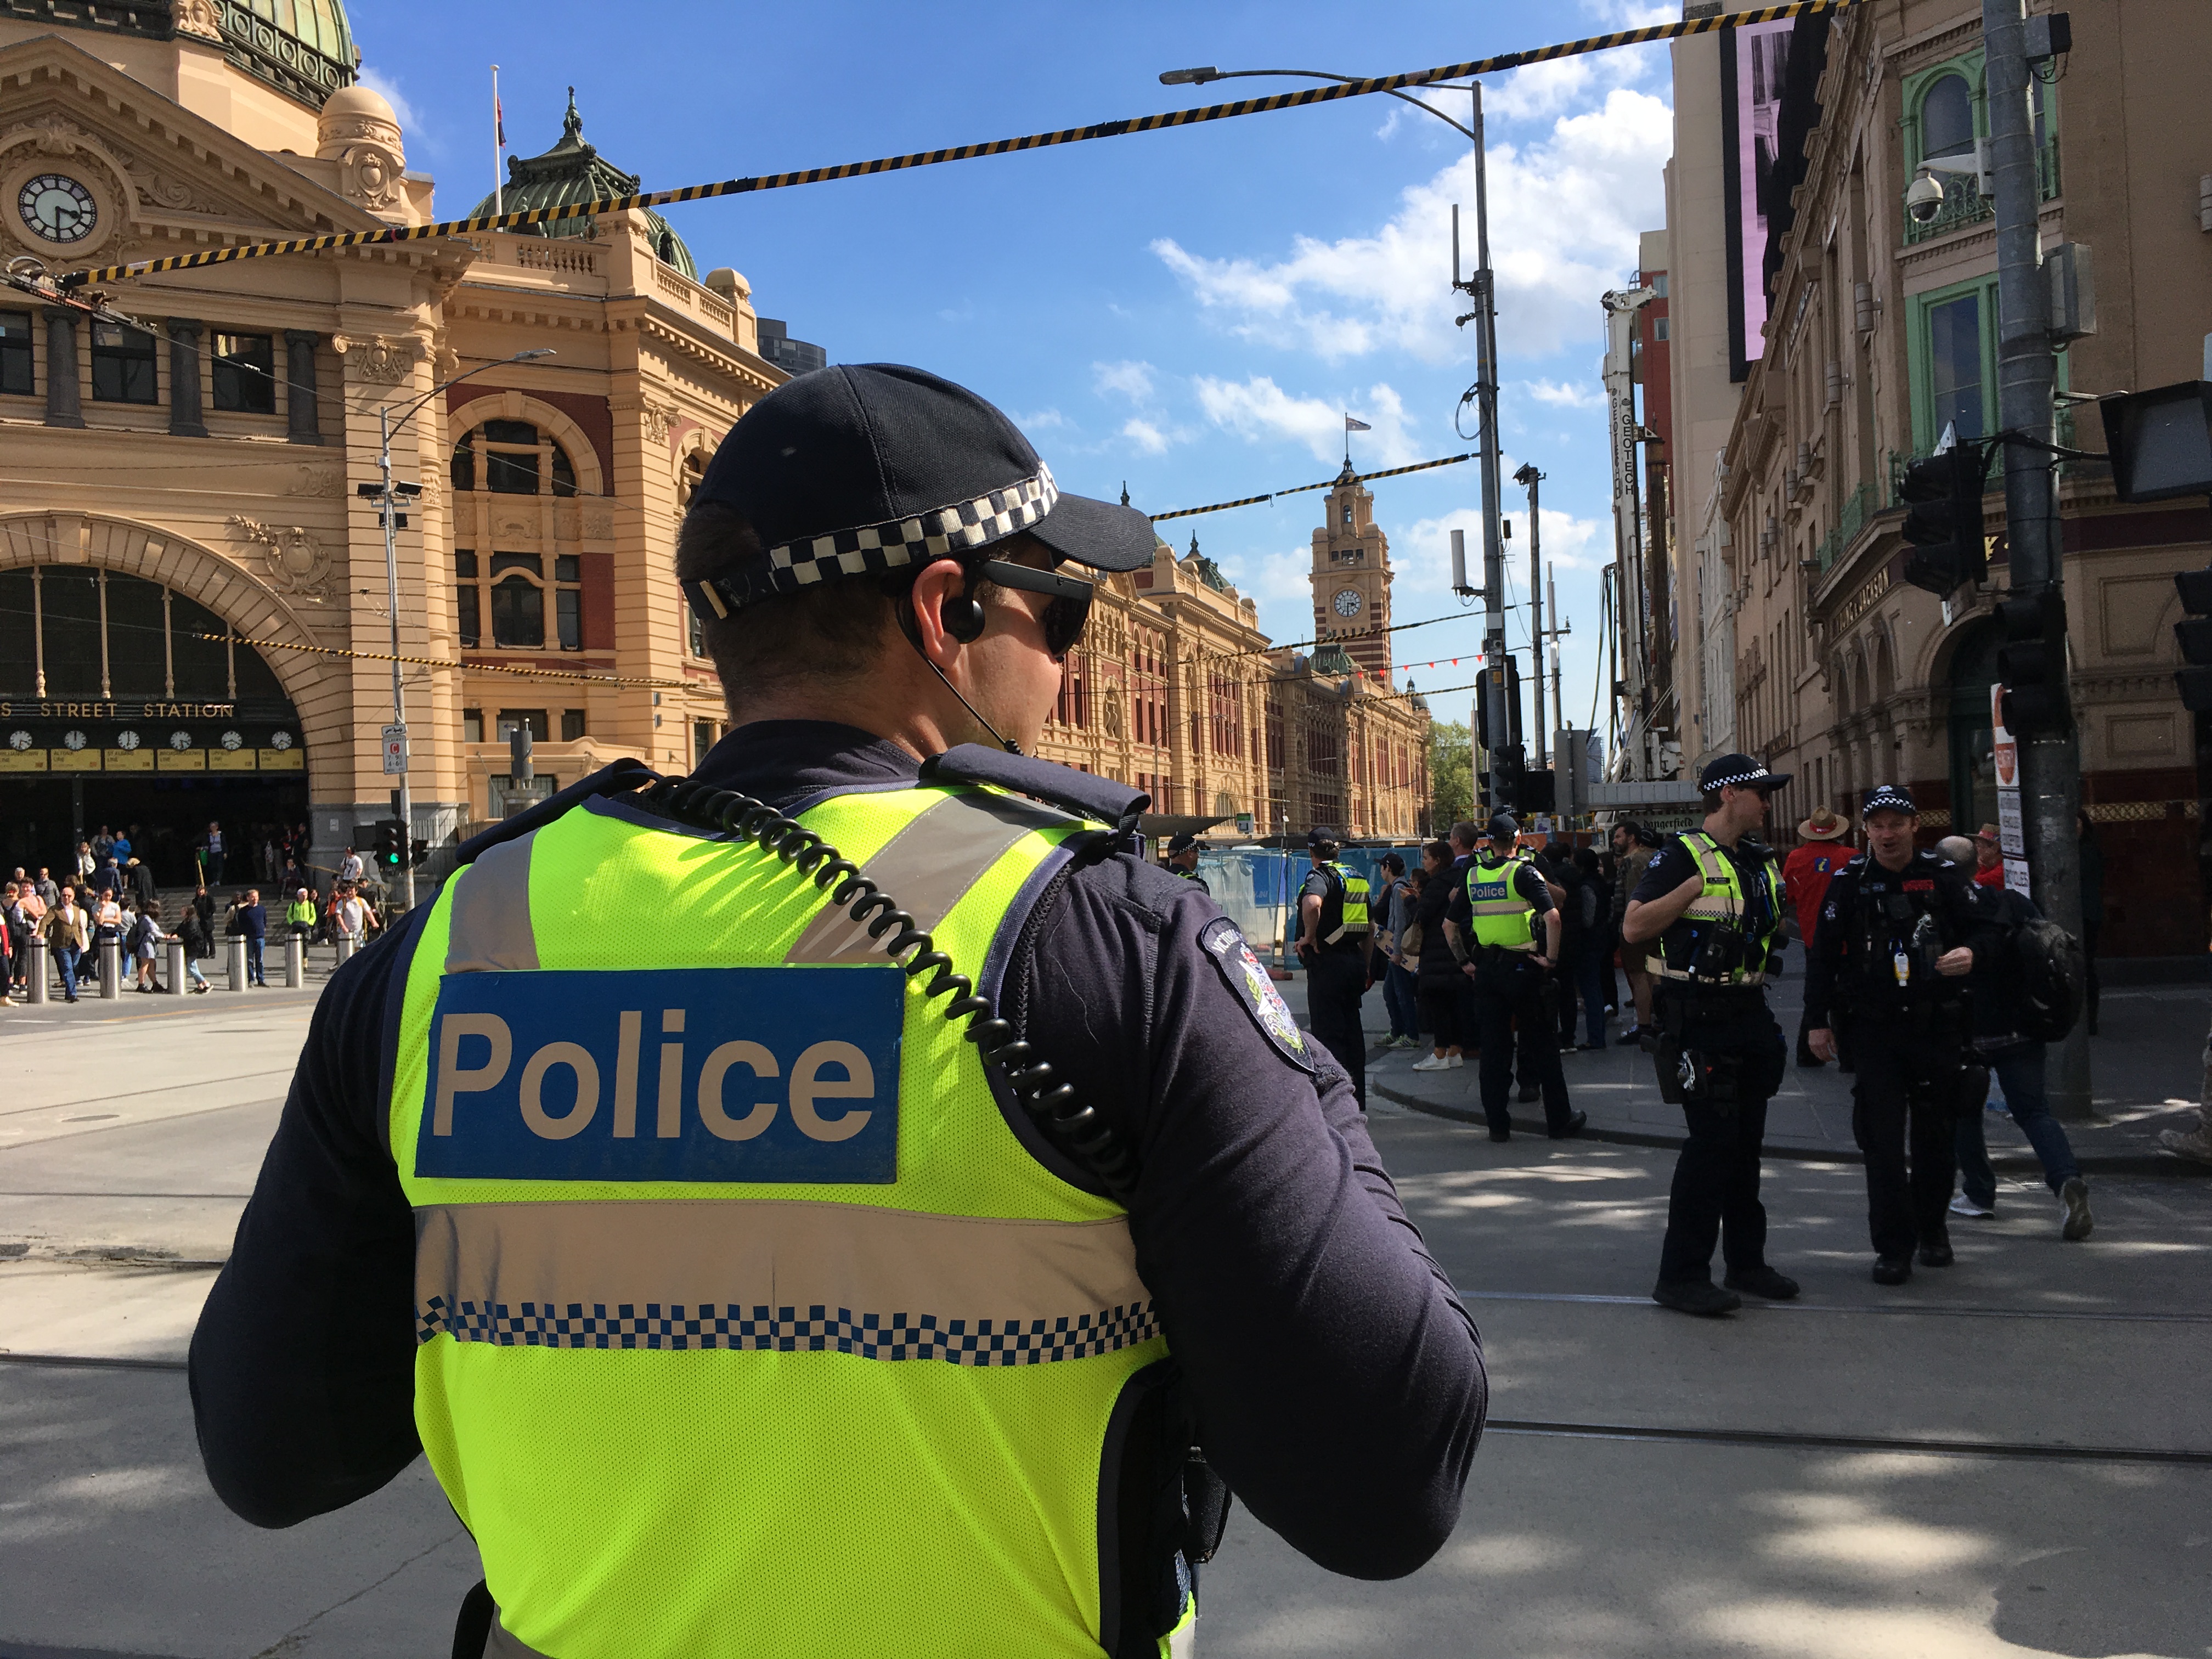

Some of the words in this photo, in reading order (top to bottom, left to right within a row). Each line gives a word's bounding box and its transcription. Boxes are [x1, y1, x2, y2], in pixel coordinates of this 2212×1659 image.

[1622, 414, 1634, 495] GEOTECH
[1859, 566, 1889, 612] JACKSON
[41, 703, 117, 718] STREET
[144, 703, 234, 718] STATION
[1643, 817, 1692, 831] dangerfield
[1470, 885, 1505, 899] Police
[432, 1008, 876, 1142] Police
